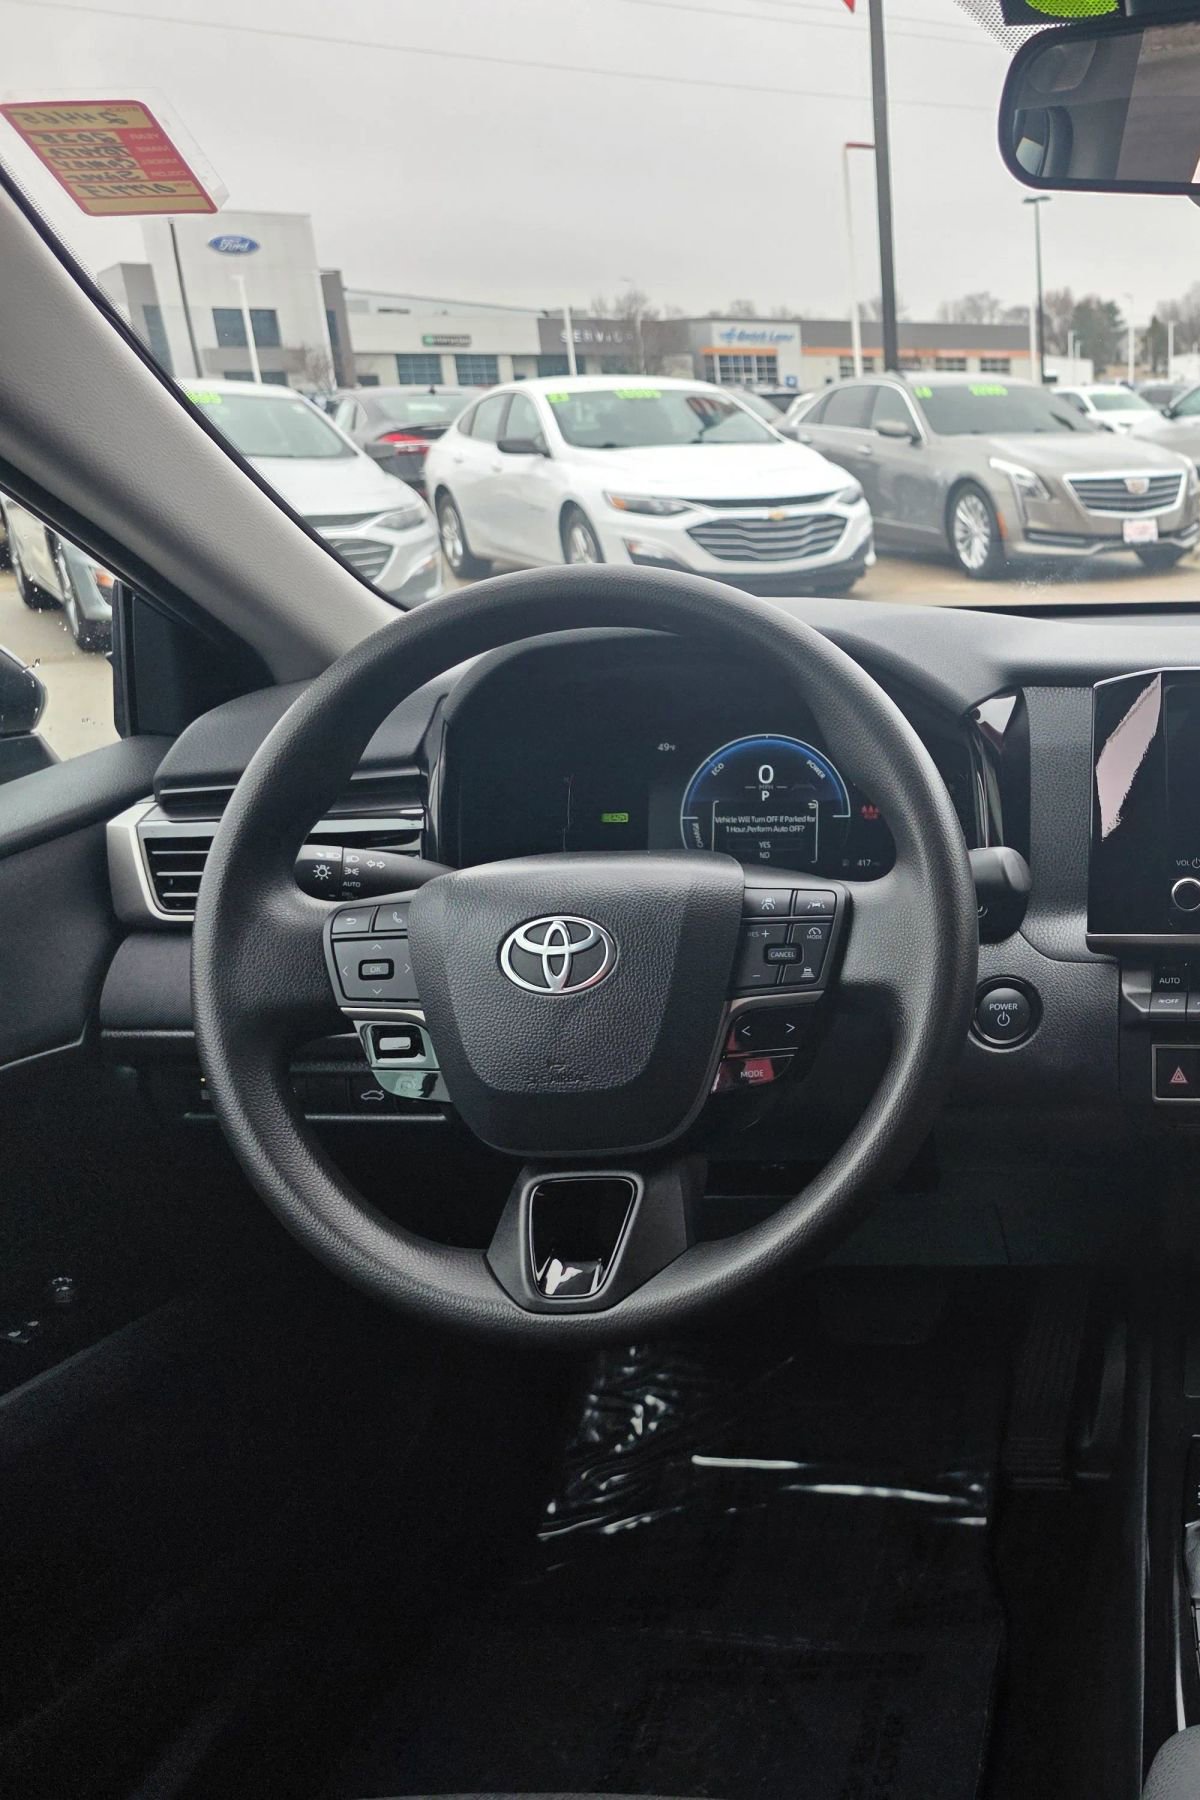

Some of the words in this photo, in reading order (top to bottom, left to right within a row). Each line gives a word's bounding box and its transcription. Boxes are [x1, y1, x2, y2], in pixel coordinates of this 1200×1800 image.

[711, 762, 725, 776] ECO
[806, 759, 826, 779] POWER
[762, 791, 770, 801] P
[784, 815, 806, 823] Parked
[806, 815, 816, 823] for
[989, 1003, 1018, 1011] POWER
[740, 1069, 764, 1078] MODE
